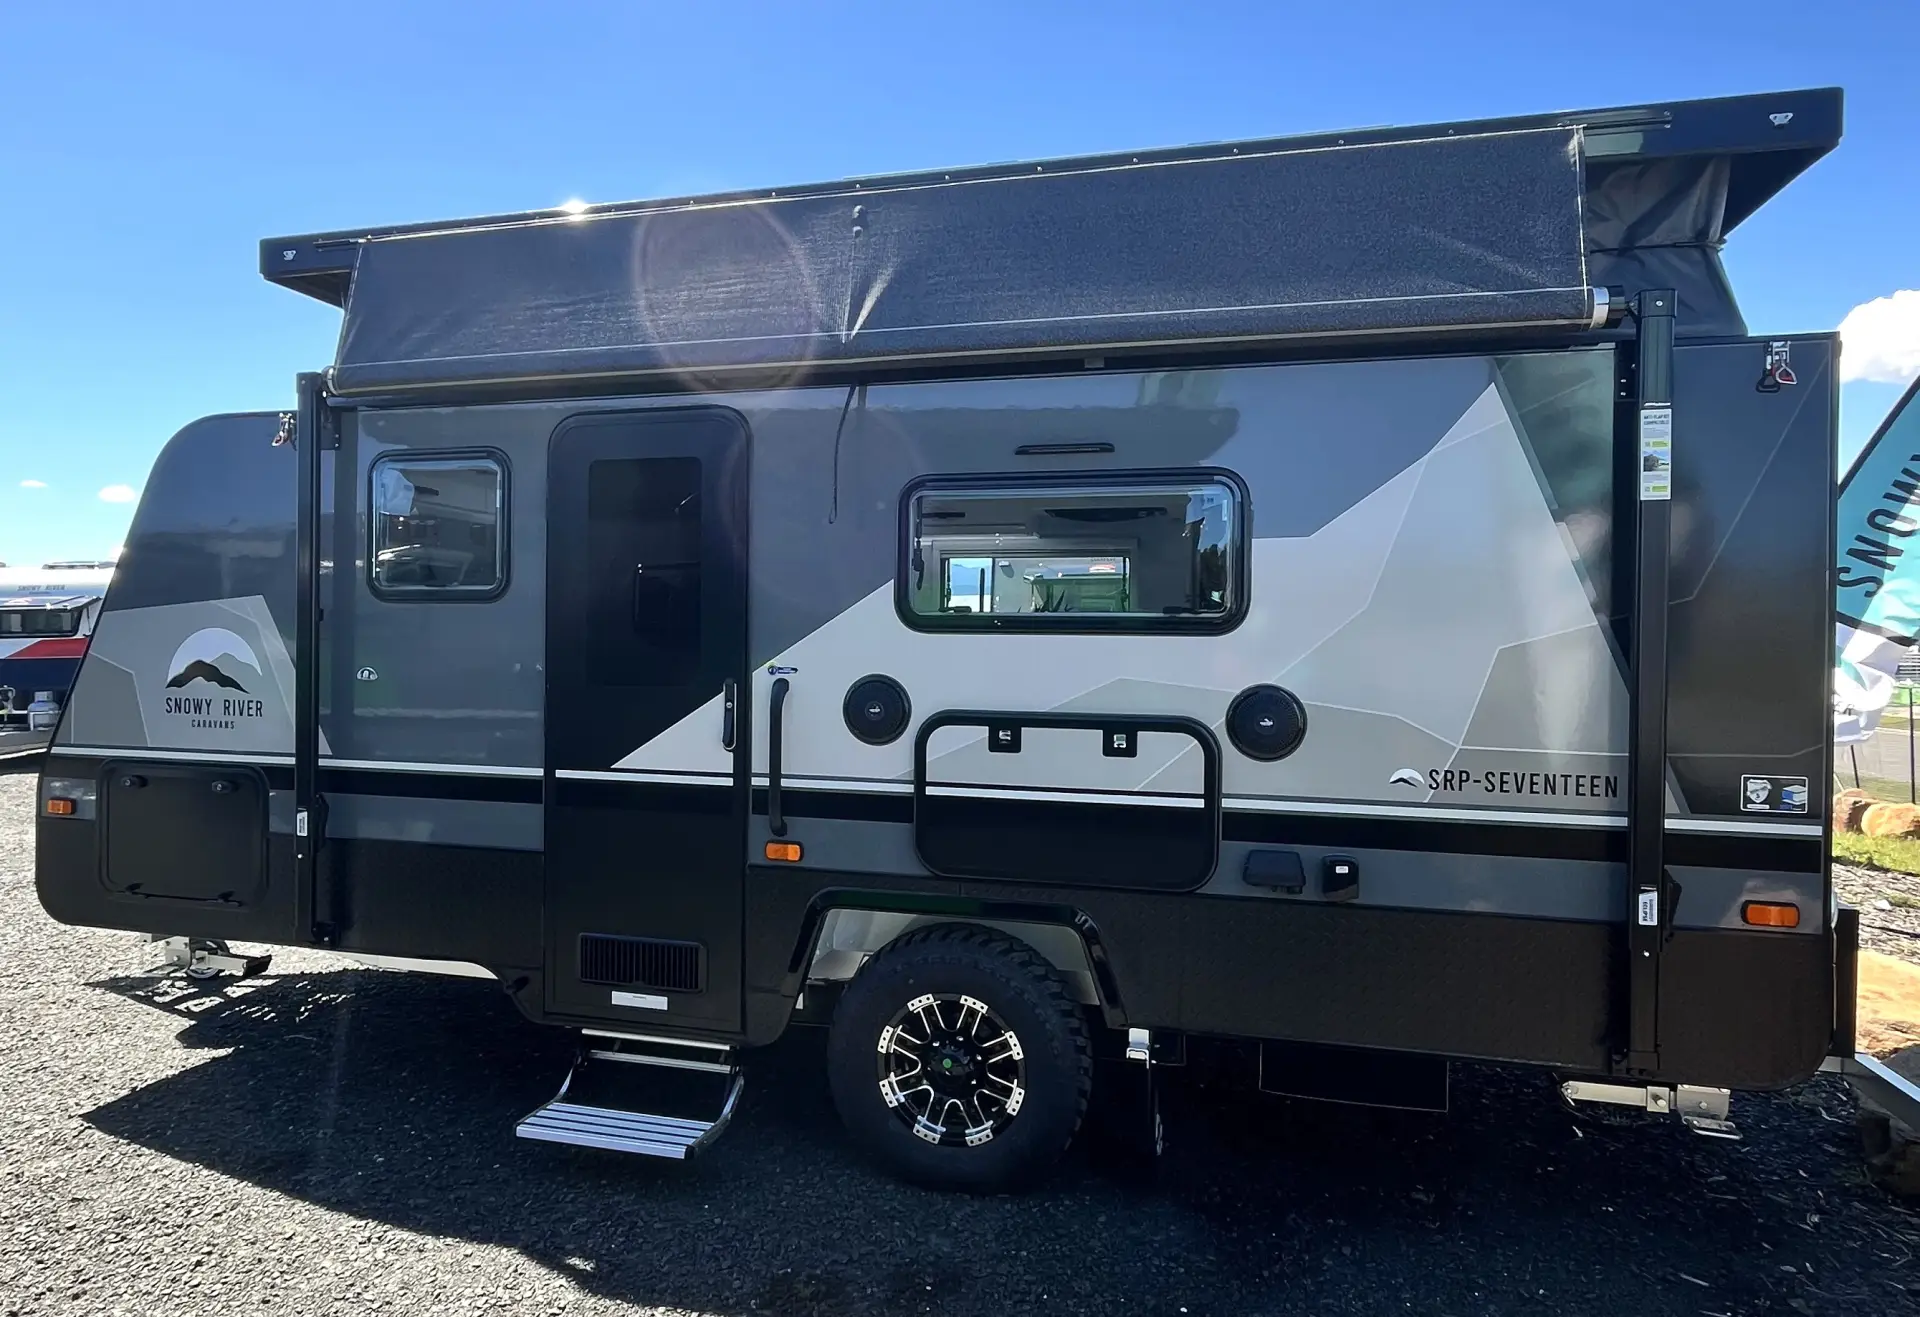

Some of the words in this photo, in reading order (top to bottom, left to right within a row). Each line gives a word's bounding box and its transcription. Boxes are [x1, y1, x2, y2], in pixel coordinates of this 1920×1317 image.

[1836, 454, 1920, 598] SNOW
[165, 697, 213, 715] SNOWY
[223, 699, 263, 717] RIVER
[191, 719, 235, 729] CARAVANS
[1428, 768, 1618, 798] SRP-SEVENTEEN
